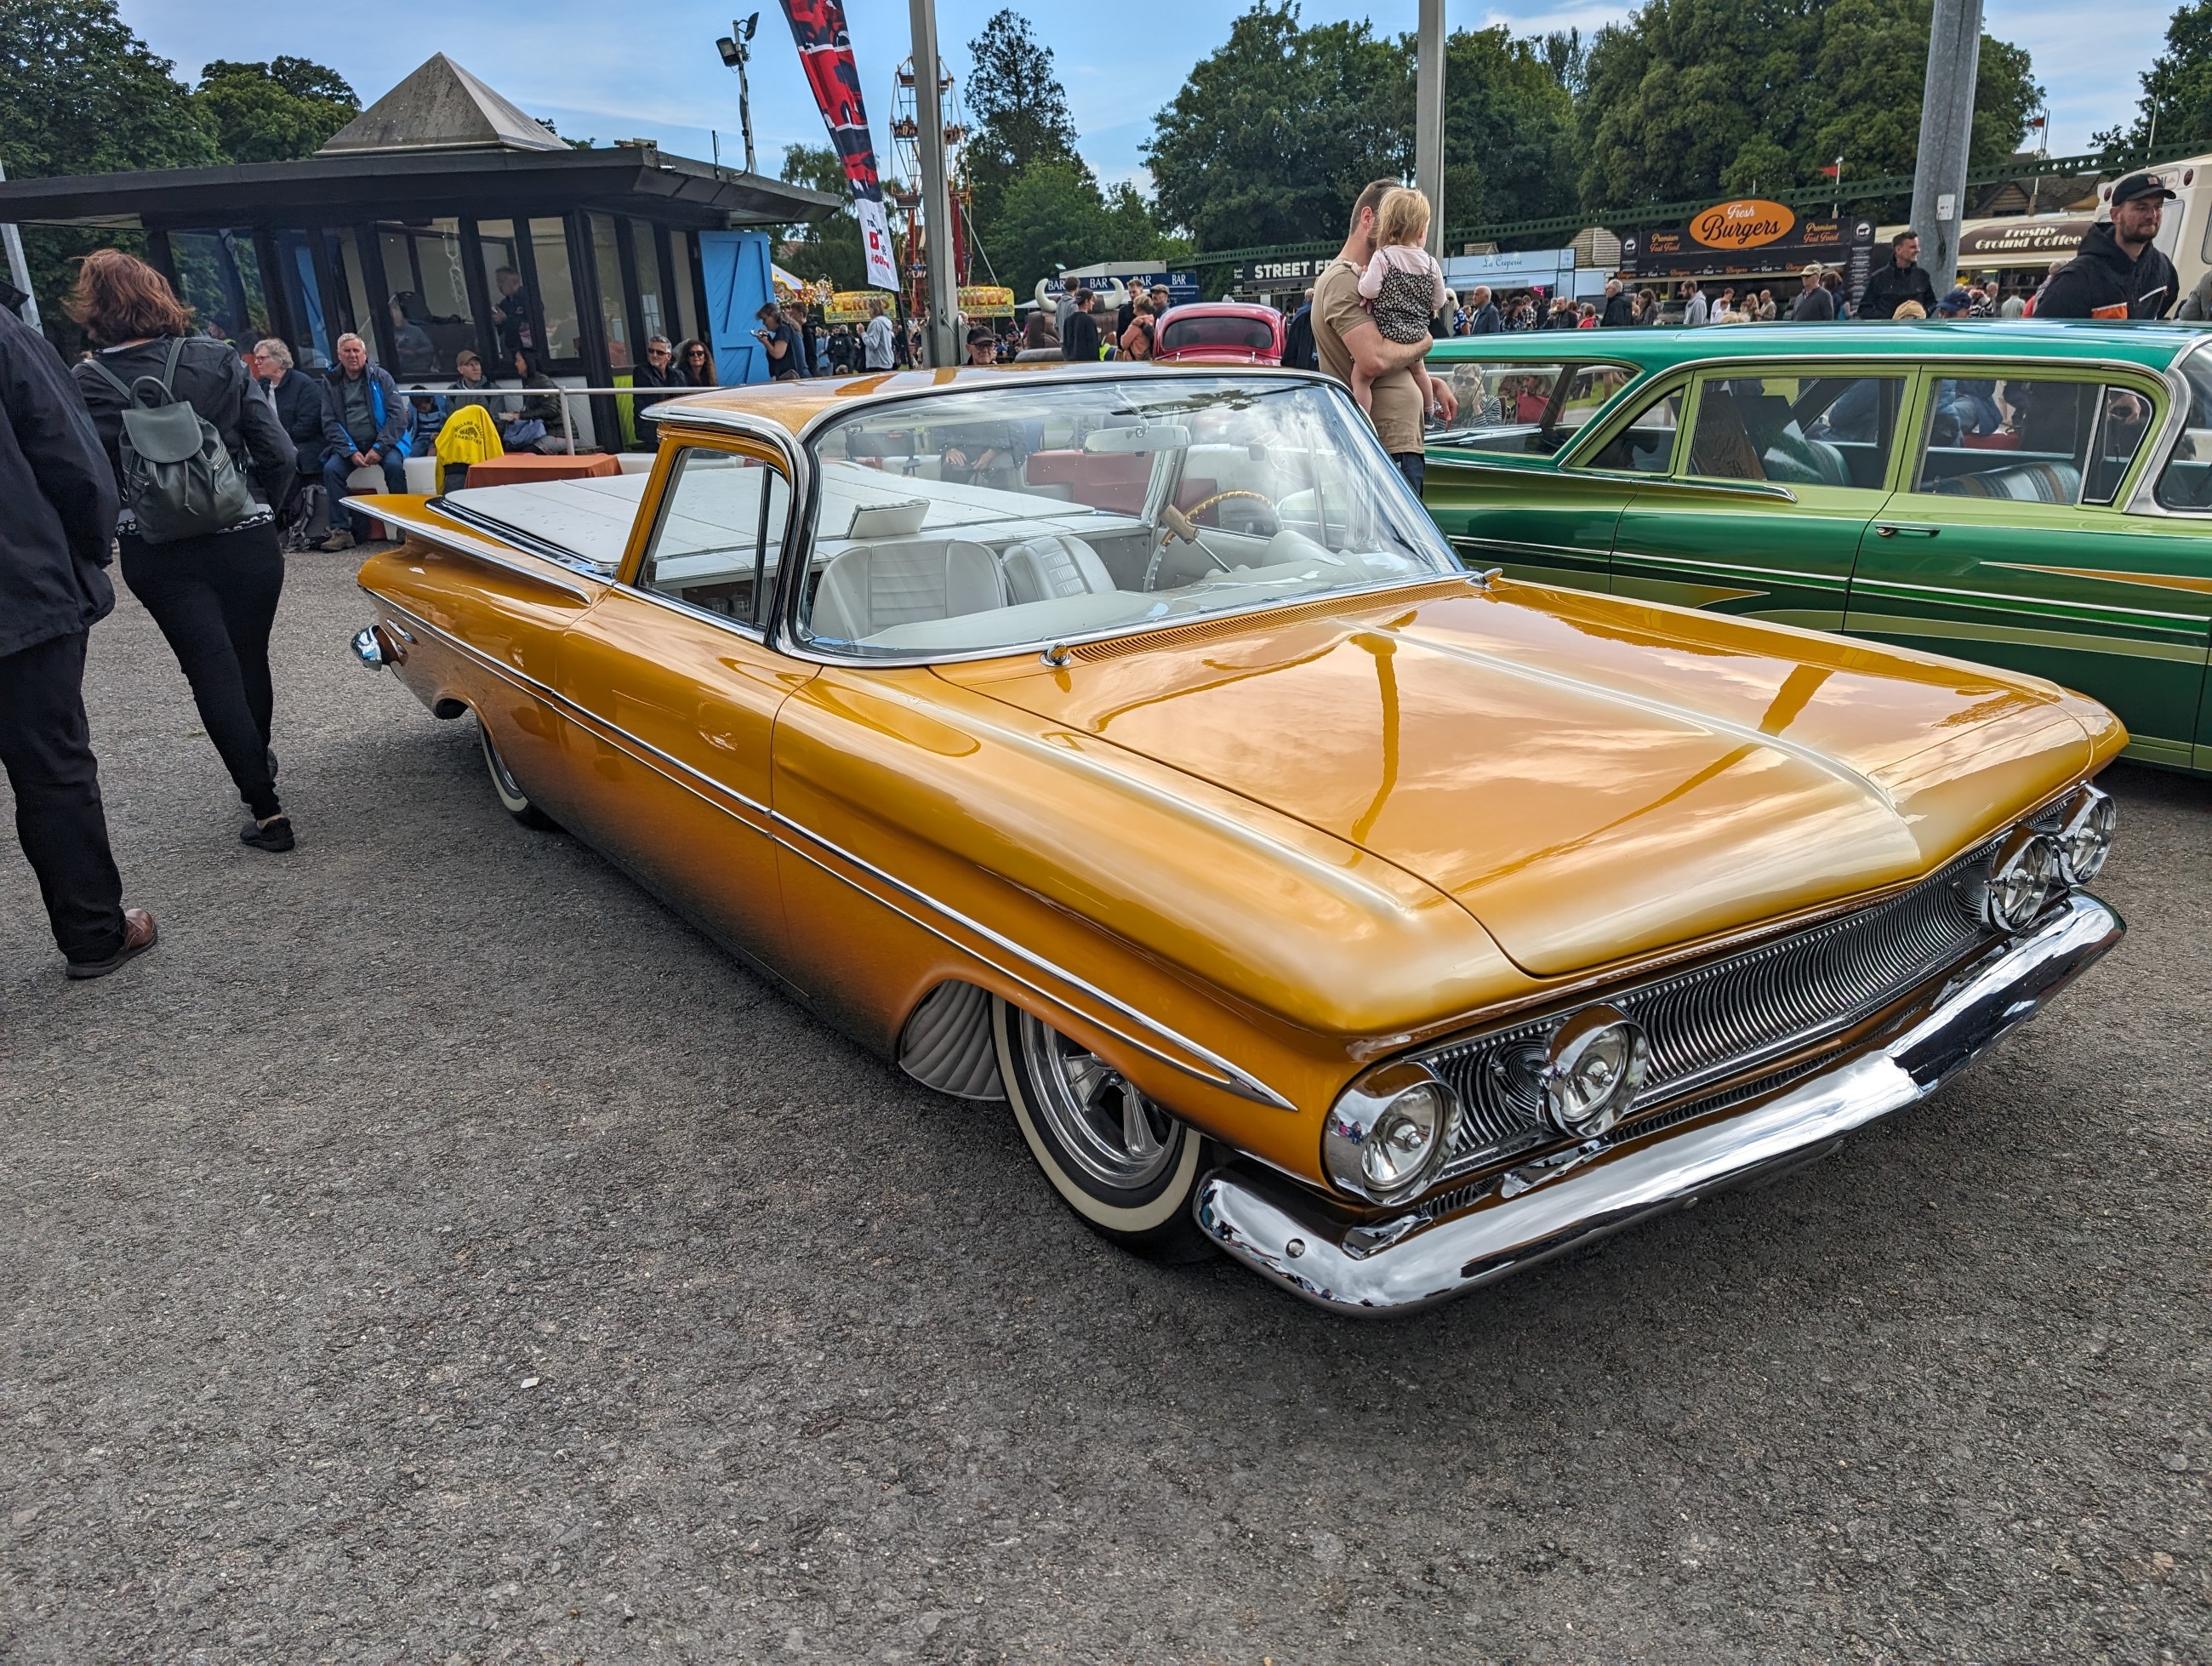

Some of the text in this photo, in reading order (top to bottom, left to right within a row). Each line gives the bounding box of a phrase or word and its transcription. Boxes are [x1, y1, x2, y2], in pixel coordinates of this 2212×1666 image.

[1727, 204, 1755, 220] Fresh
[1702, 214, 1781, 245] Burgers
[1805, 222, 1838, 232] Premium
[2004, 226, 2060, 237] Freshly
[1652, 233, 1679, 243] Premium
[1804, 231, 1839, 243] Fast Food
[1975, 234, 2082, 250] Ground Coffee
[1650, 242, 1680, 253] Fast Food
[1483, 256, 1493, 268] La
[1254, 261, 1310, 279] STREET
[1048, 280, 1066, 291] BAR
[1090, 278, 1108, 288] BAR
[1172, 274, 1186, 285] BAR
